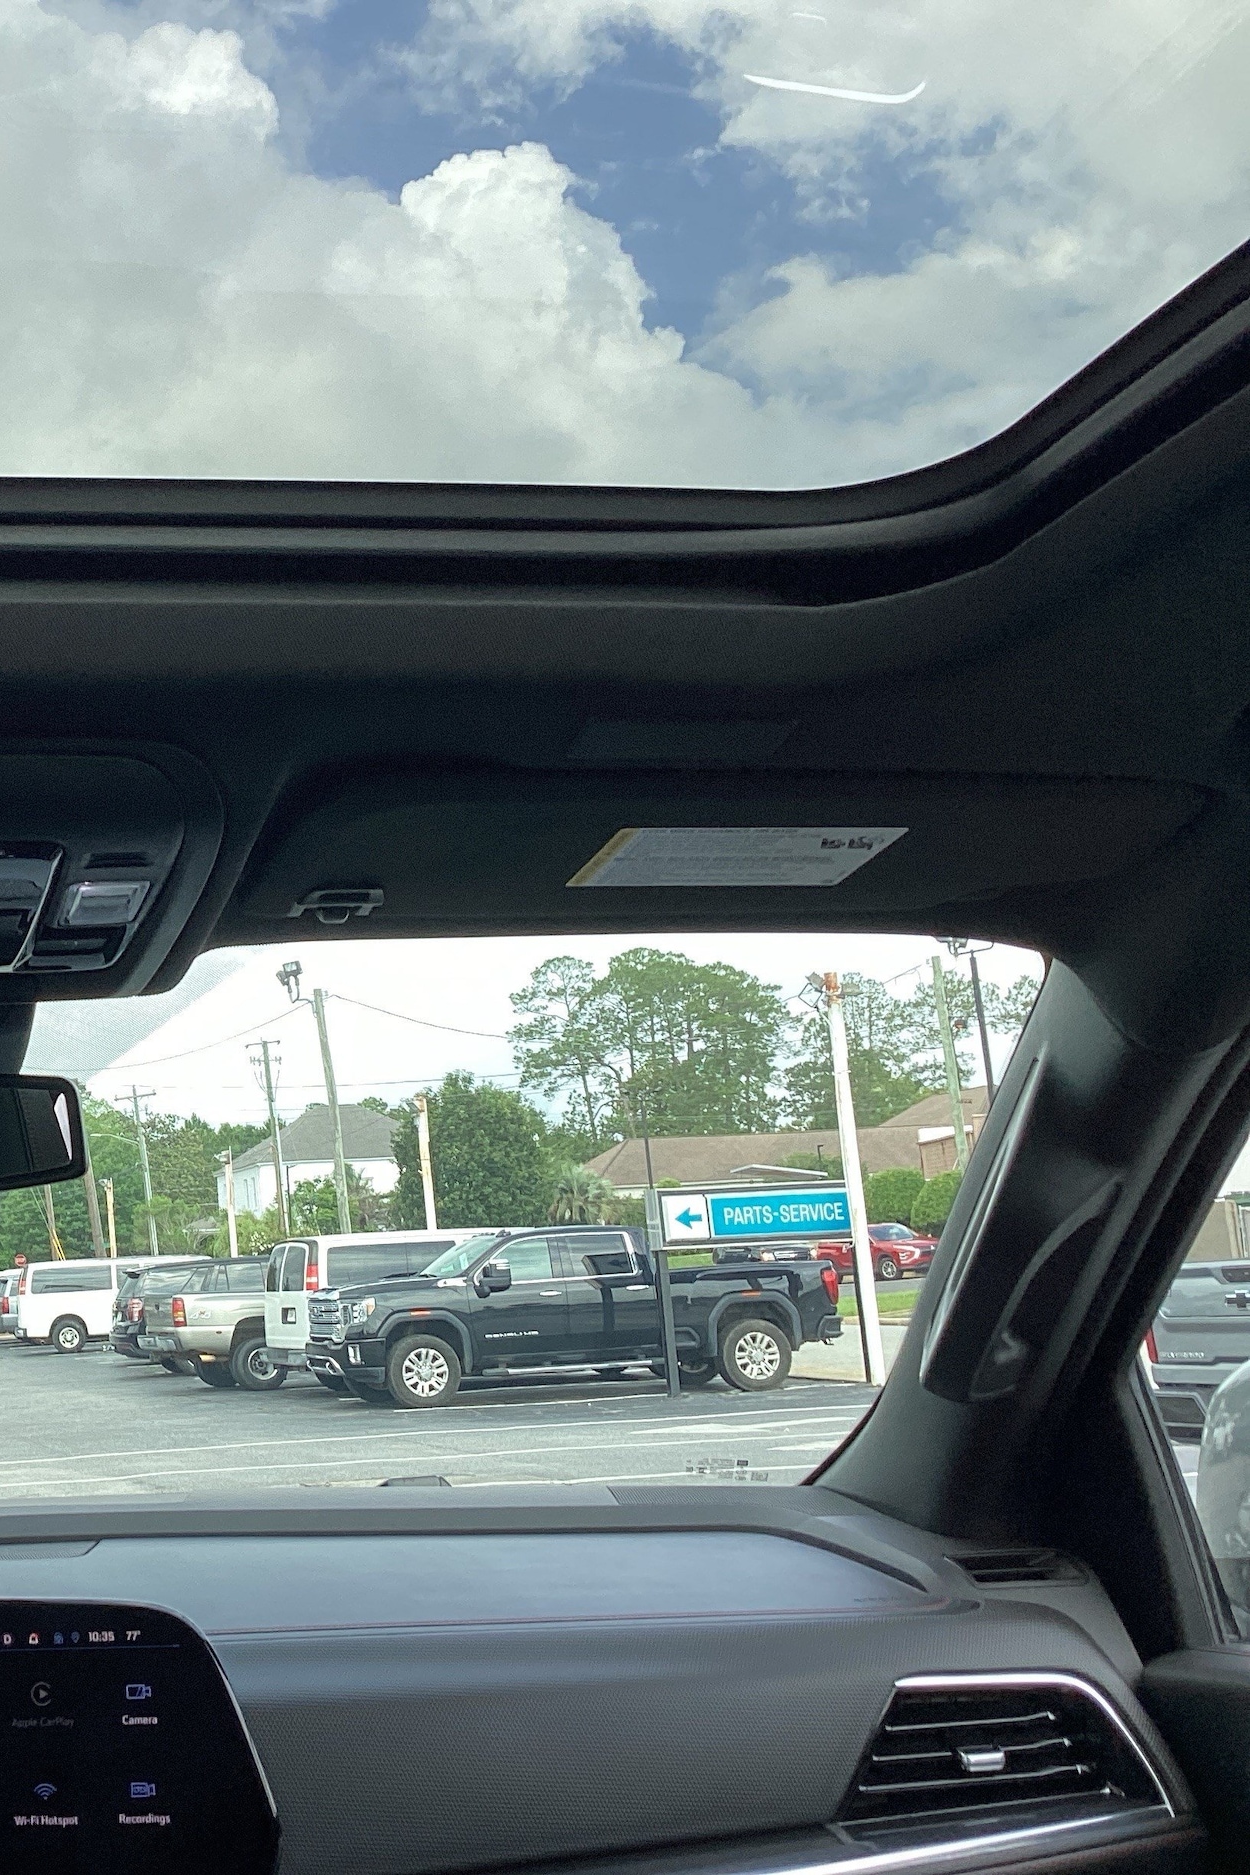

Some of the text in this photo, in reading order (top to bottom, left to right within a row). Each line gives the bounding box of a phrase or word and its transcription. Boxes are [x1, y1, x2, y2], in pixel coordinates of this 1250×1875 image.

[723, 1202, 845, 1226] PARTS-SERVICE
[122, 1714, 158, 1726] Camera
[14, 1815, 78, 1828] Wi-Fi Hotspot
[118, 1813, 170, 1825] Recordings
